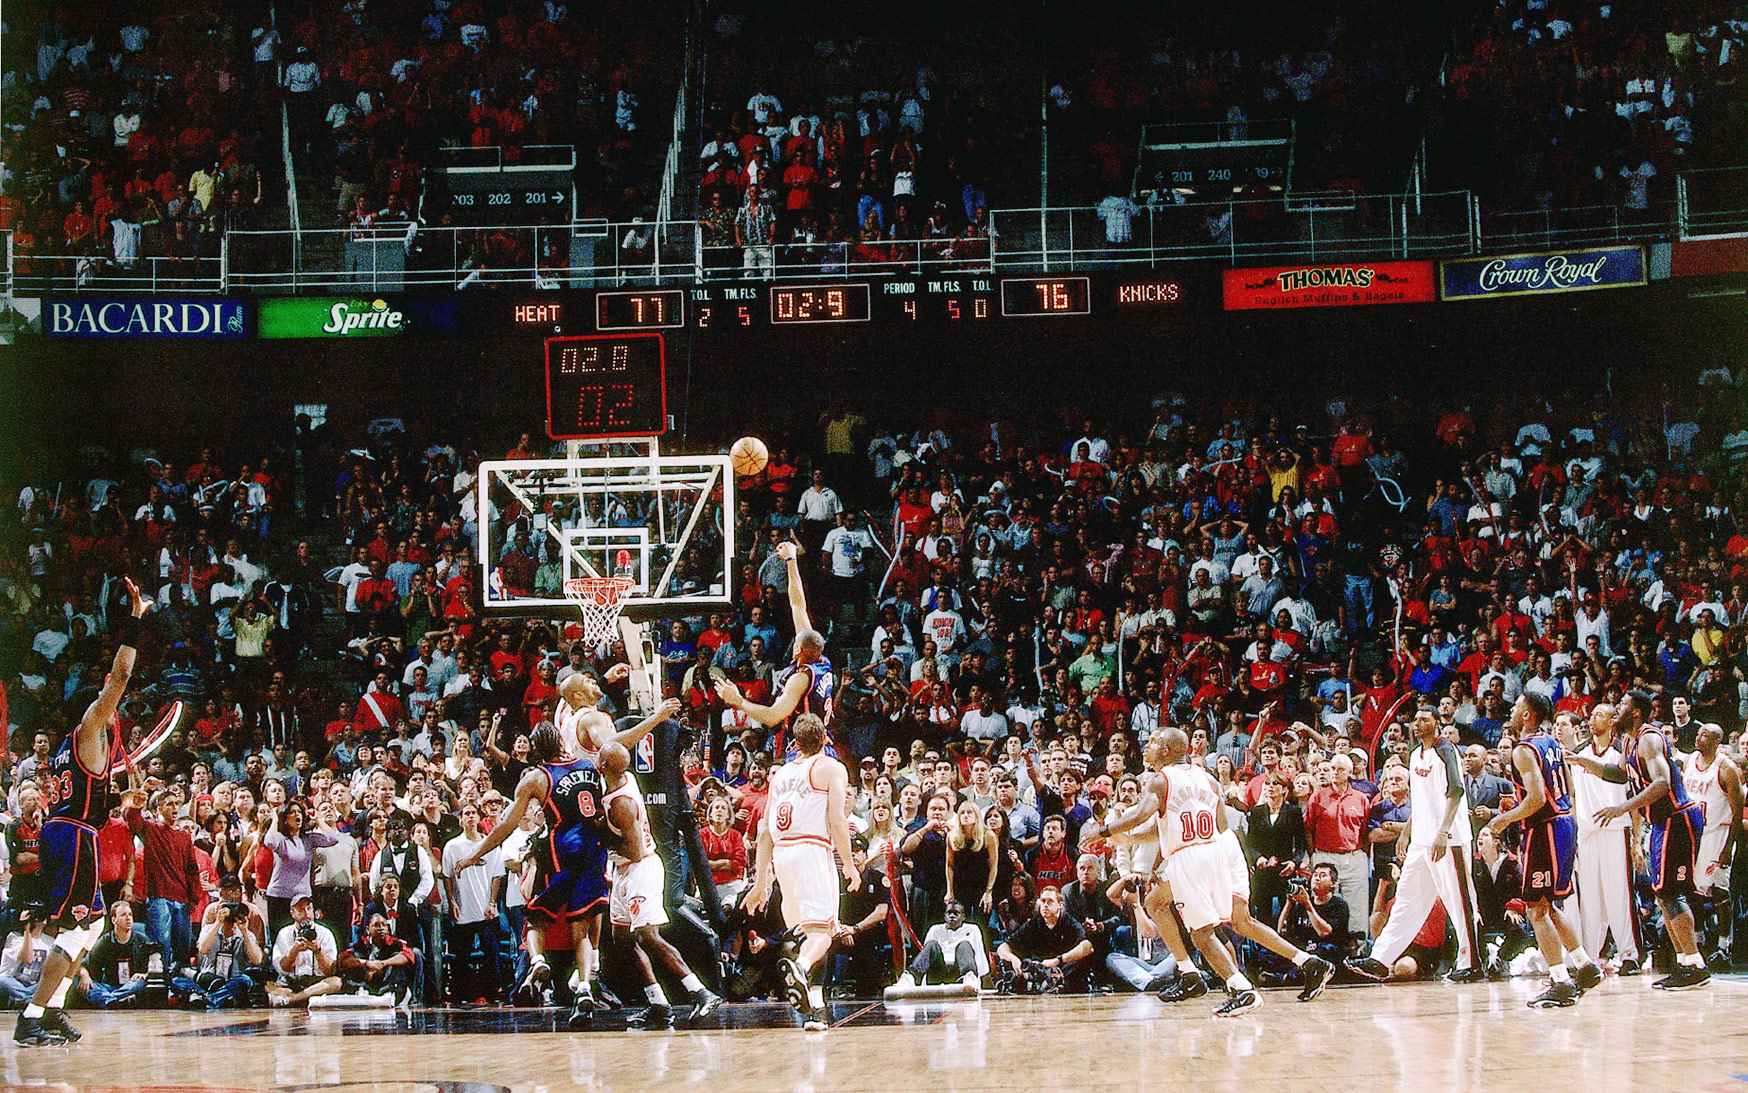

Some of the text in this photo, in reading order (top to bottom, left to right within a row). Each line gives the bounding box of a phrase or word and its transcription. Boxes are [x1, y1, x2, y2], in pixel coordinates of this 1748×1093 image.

[1172, 171, 1194, 182] 201
[1208, 168, 1231, 181] 240
[488, 193, 511, 205] 202
[525, 192, 547, 204] 201
[1277, 267, 1375, 292] THOMAS'
[1480, 255, 1607, 291] Crown Royal
[883, 282, 916, 295] PERIOD
[1035, 283, 1069, 310] 76
[1119, 283, 1179, 303] KNICKS
[1255, 291, 1404, 306] English Muffins & Bagels
[51, 303, 223, 333] BACARDI
[322, 302, 403, 334] Sprite
[514, 304, 561, 322] HEAT
[630, 297, 663, 323] 77
[699, 308, 711, 328] 2
[737, 306, 751, 326] 5
[904, 301, 916, 320] 4
[948, 299, 961, 319] 5
[974, 299, 988, 319] 0
[226, 305, 244, 334] Rum
[560, 345, 629, 374] 02.8
[577, 383, 634, 427] 02
[51, 769, 73, 805] 33
[577, 790, 597, 818] 8
[776, 801, 794, 832] 9
[1180, 809, 1214, 843] 10
[23, 838, 41, 848] HEA
[1038, 866, 1067, 880] HEAT
[1532, 870, 1553, 888] 21
[1676, 865, 1688, 881] 2
